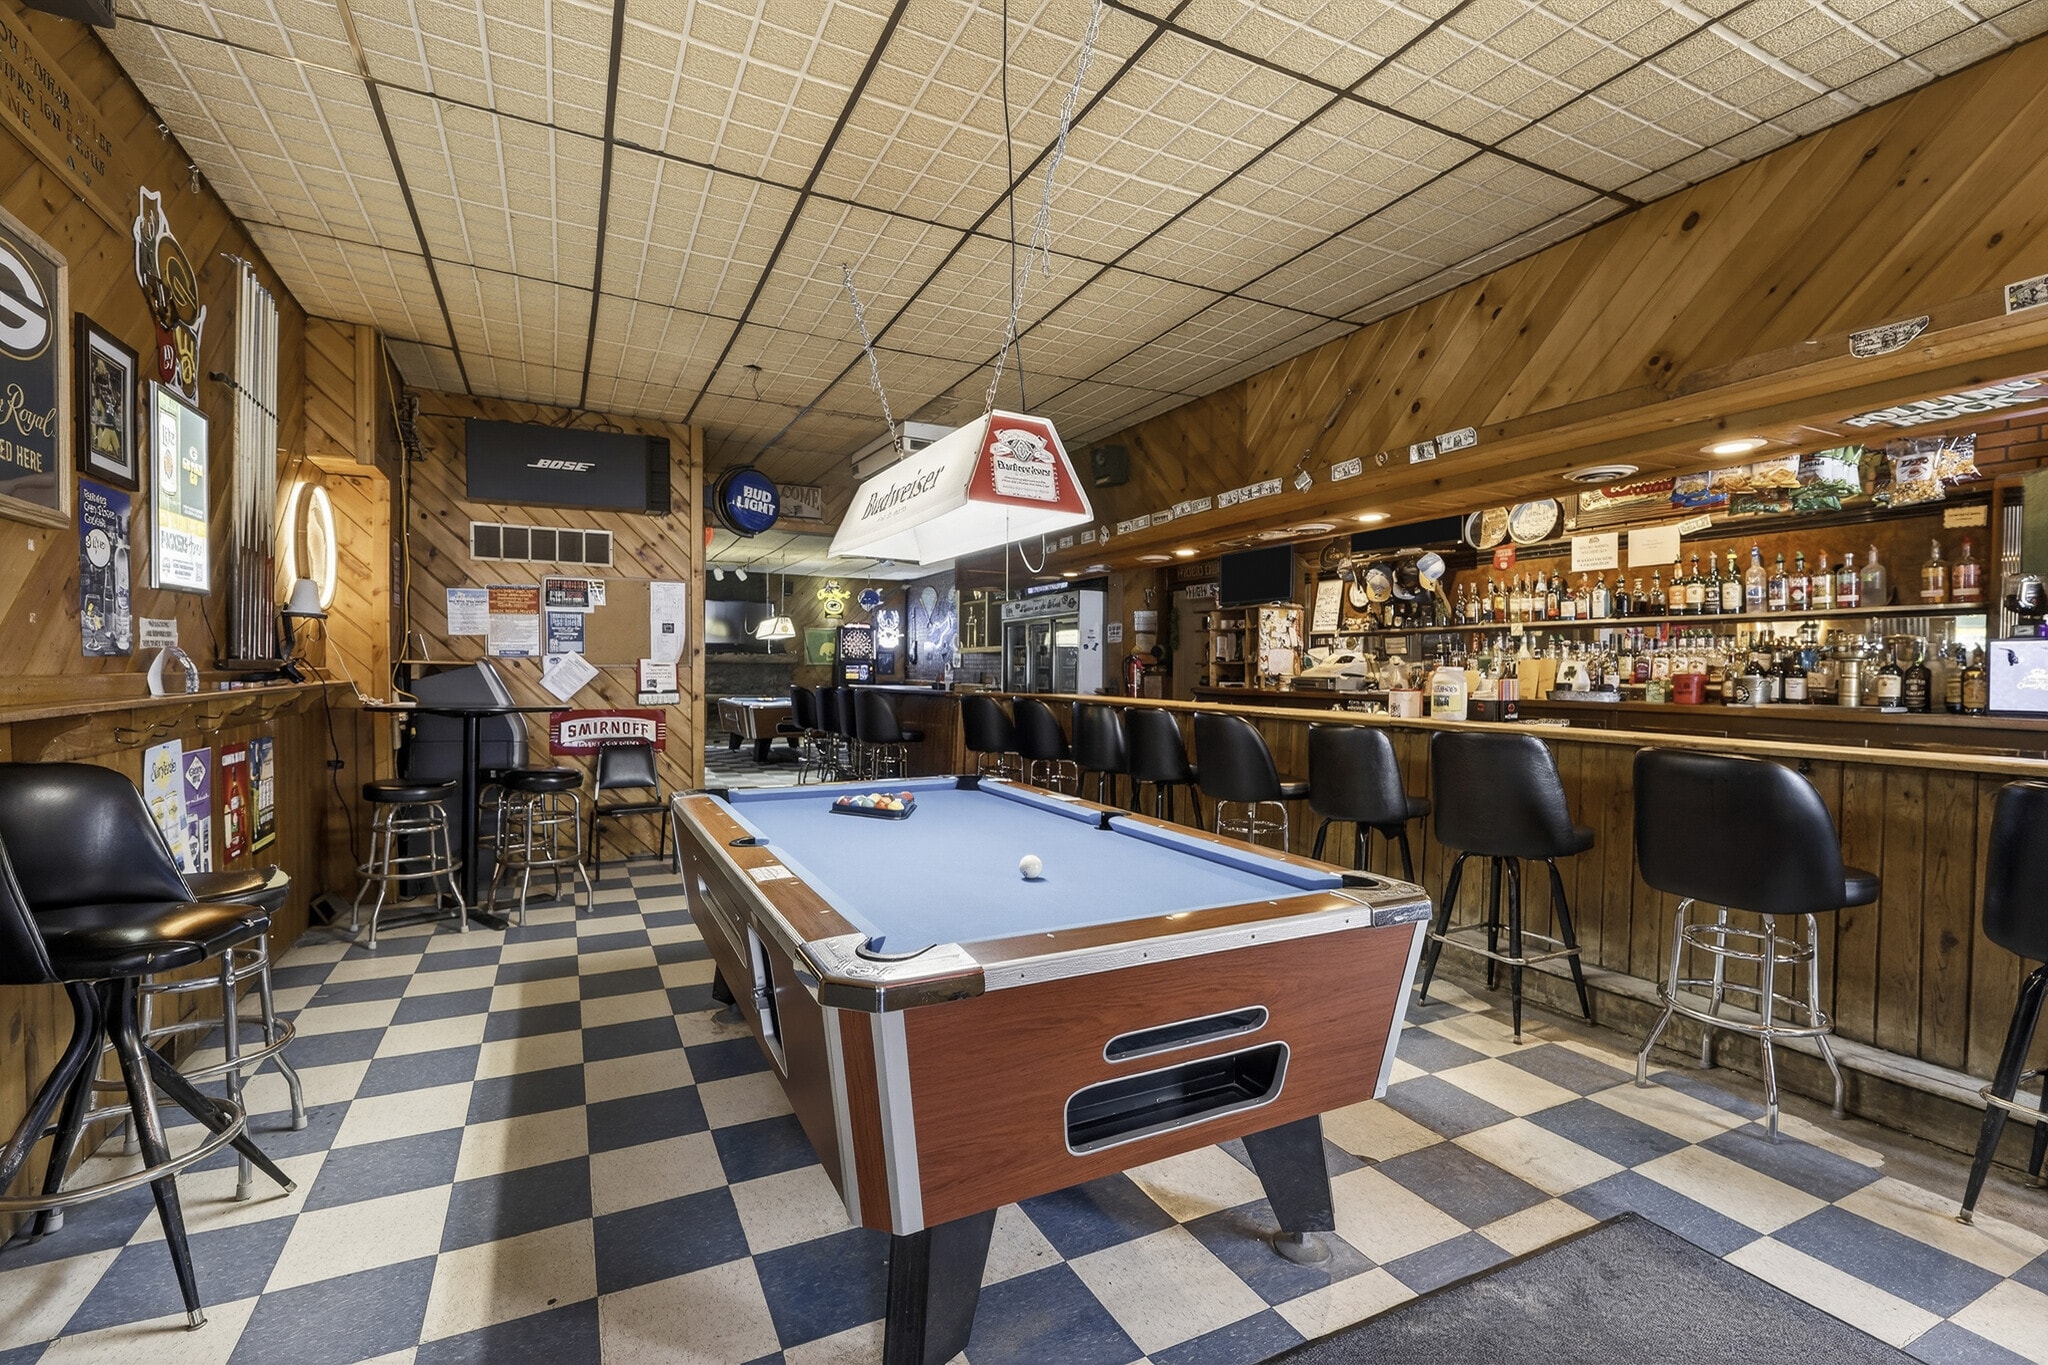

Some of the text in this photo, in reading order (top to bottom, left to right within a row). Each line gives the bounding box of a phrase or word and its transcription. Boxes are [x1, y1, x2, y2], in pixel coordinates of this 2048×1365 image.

[0, 383, 57, 438] Royal
[1843, 379, 2042, 428] ROLLING
[1889, 391, 2041, 428] ROCK
[16, 444, 43, 473] HERE
[526, 459, 596, 472] BOSE
[736, 496, 776, 516] LIGHT
[743, 485, 772, 503] BUD
[861, 465, 945, 521] Budweiser
[567, 721, 650, 738] SMIRNOFF
